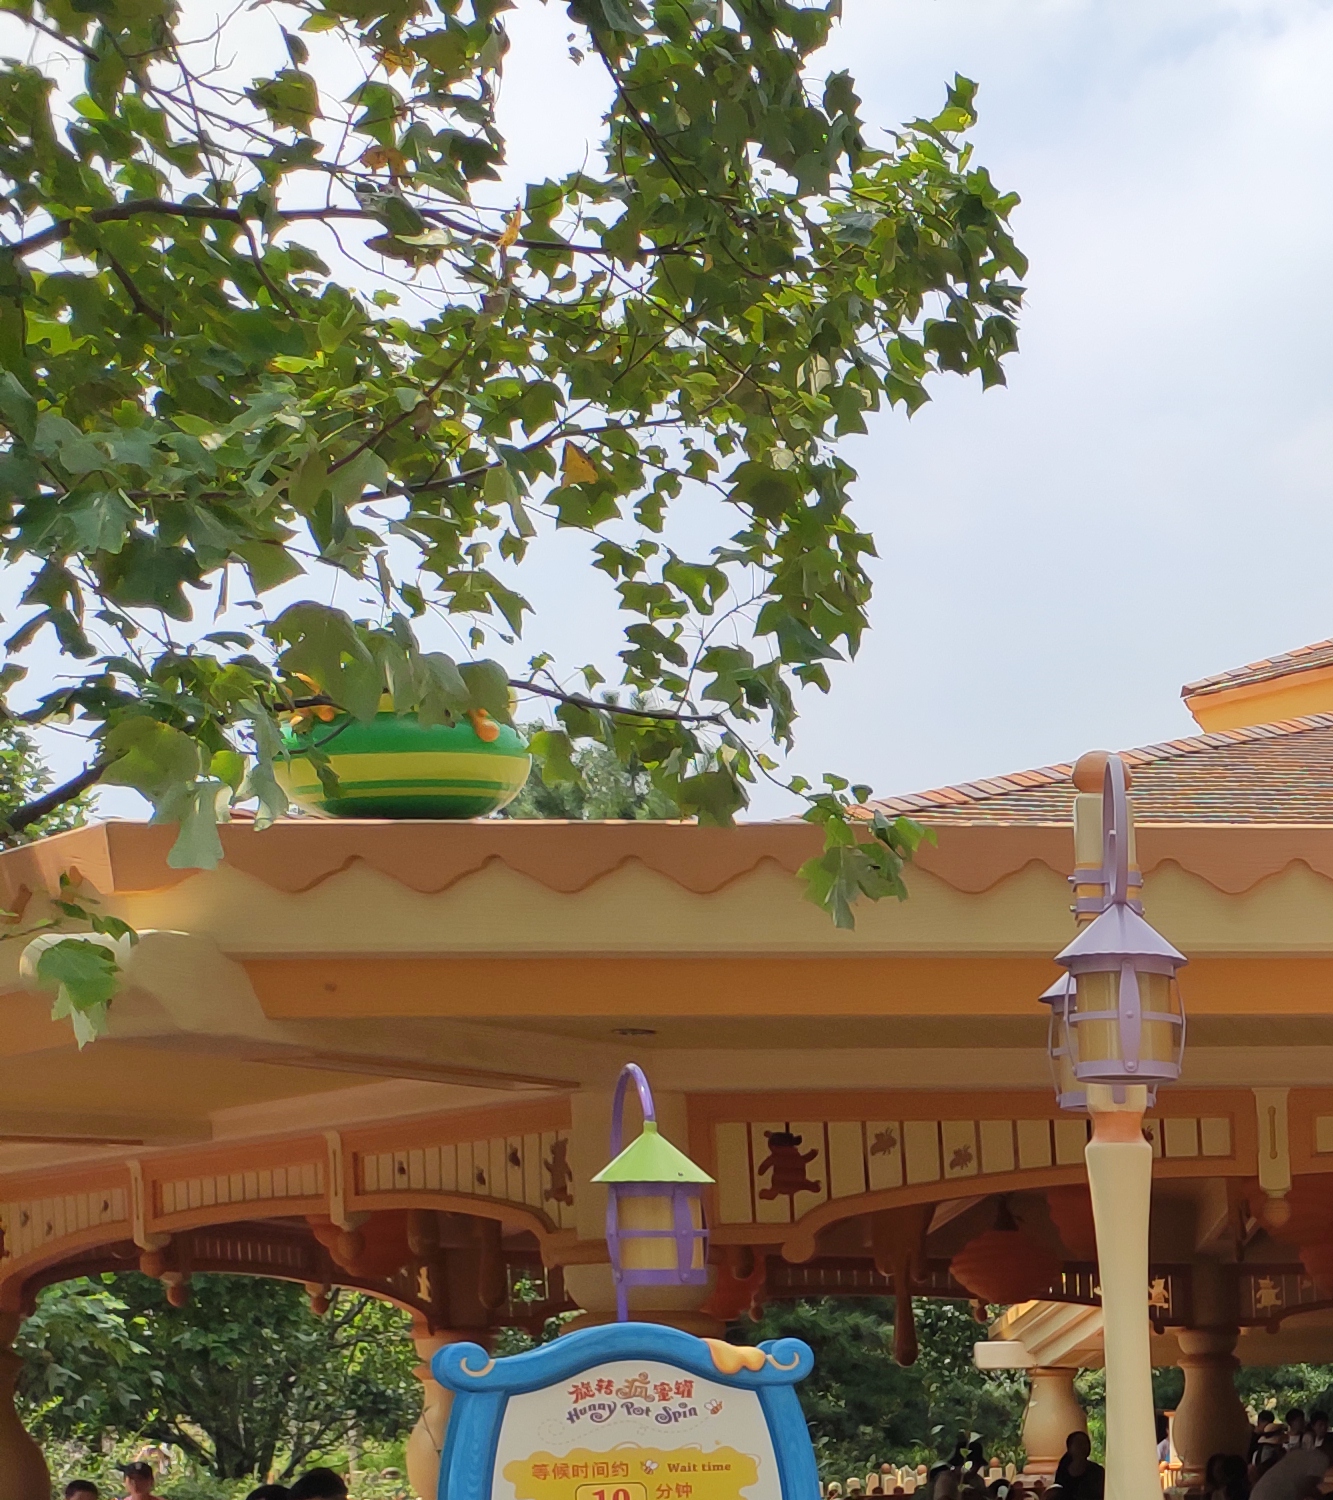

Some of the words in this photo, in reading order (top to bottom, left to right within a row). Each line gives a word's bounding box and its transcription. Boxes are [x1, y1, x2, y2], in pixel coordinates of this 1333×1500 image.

[567, 1372, 695, 1403] 旋转疯蜜罐
[566, 1401, 617, 1424] Hunny
[620, 1402, 652, 1417] Pot
[655, 1402, 699, 1424] Spin
[531, 1460, 630, 1480] 等候时间约
[667, 1462, 698, 1473] Wait
[701, 1461, 732, 1472] time
[656, 1482, 693, 1500] 分钟
